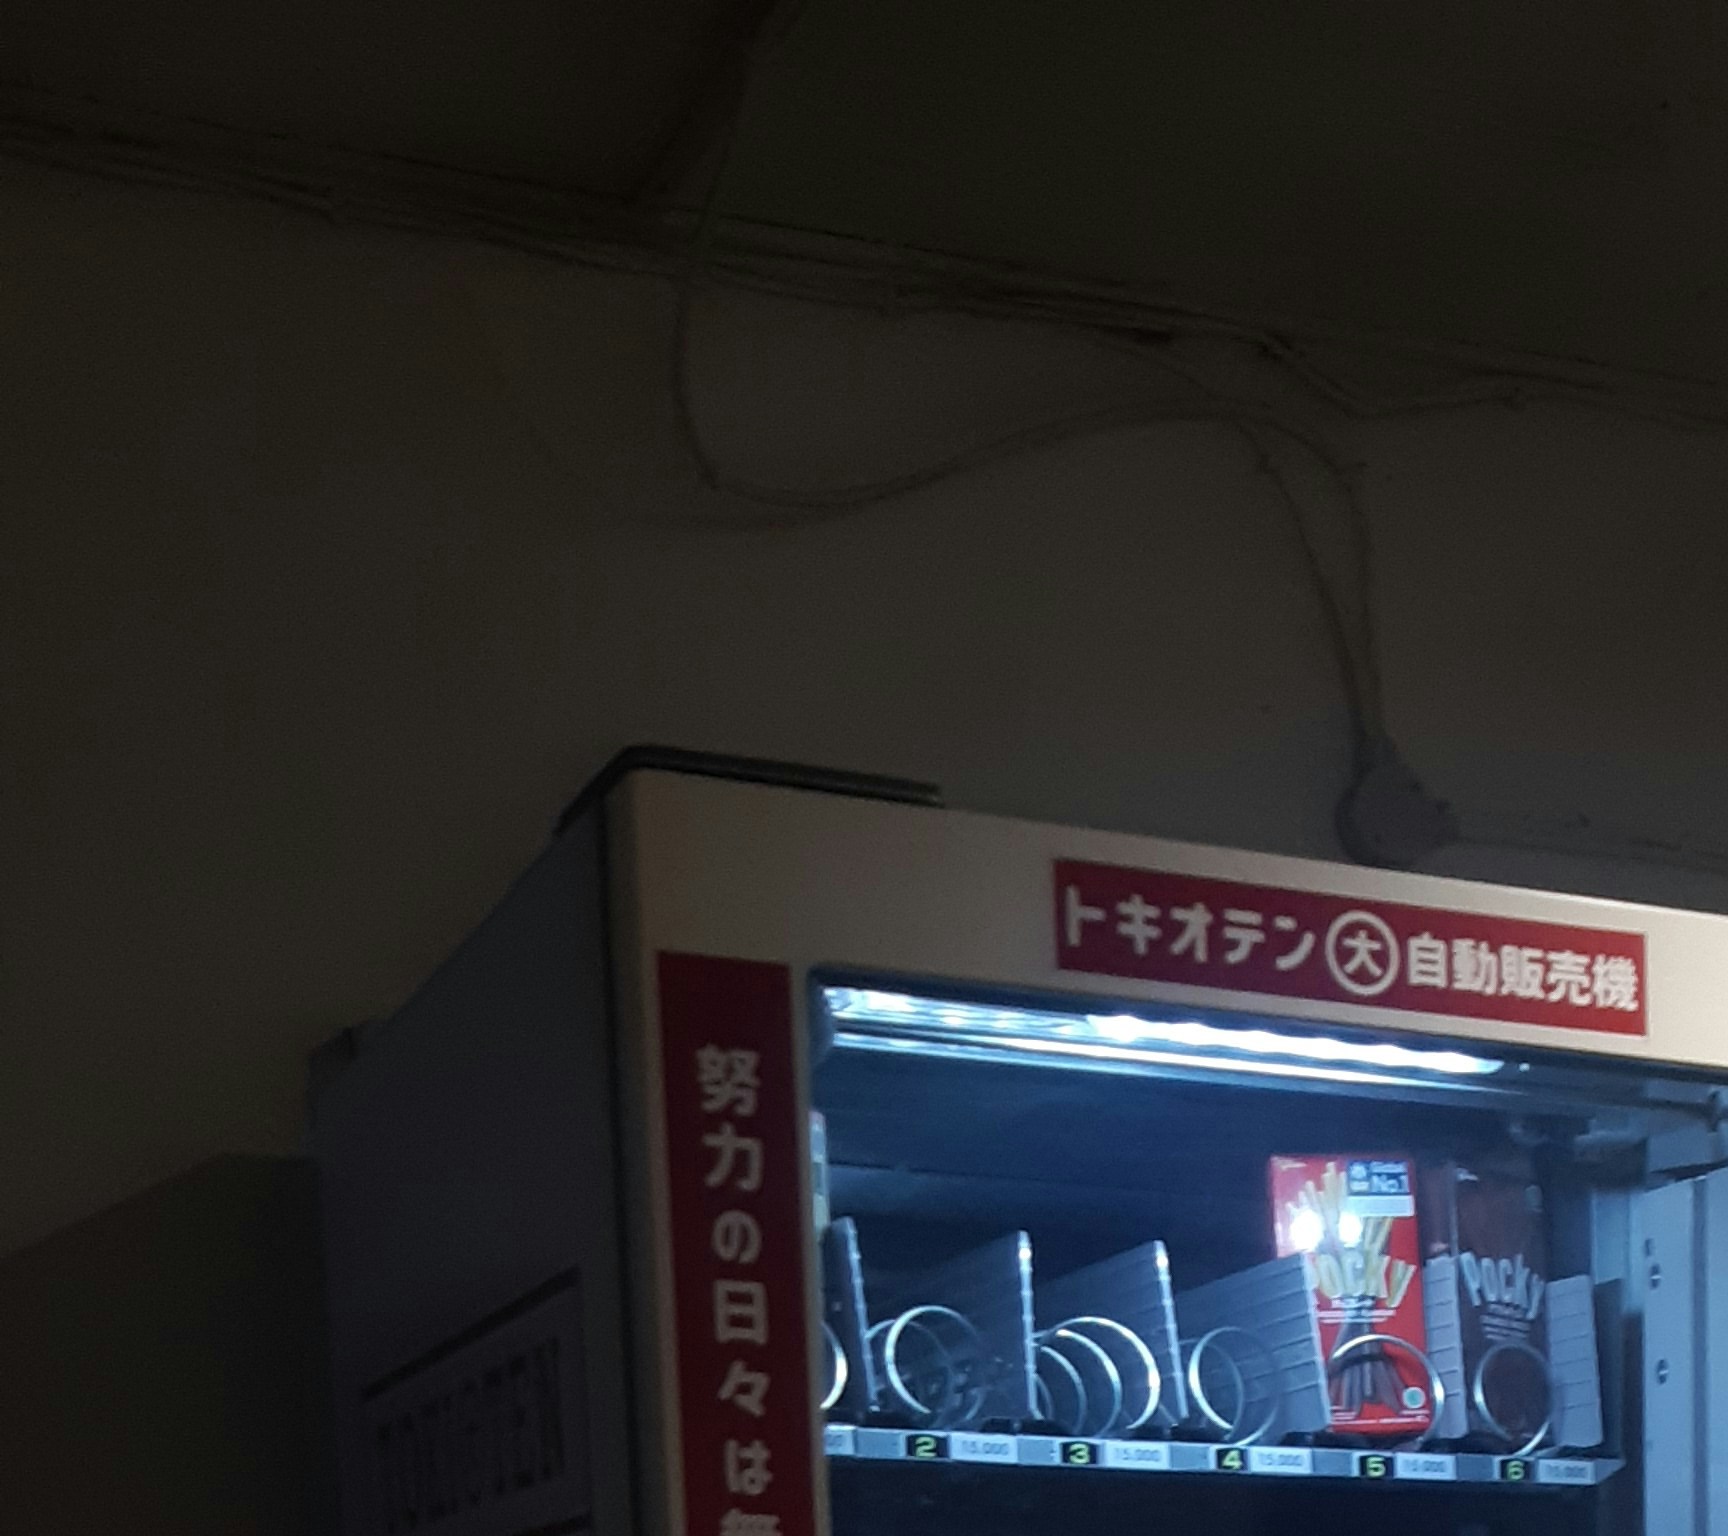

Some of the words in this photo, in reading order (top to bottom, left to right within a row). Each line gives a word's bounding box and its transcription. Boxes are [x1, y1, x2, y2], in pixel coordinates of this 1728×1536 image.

[1062, 884, 1315, 971] トキオテン
[1407, 931, 1639, 1012] 自動販売機
[913, 1436, 938, 1459] 2
[1068, 1443, 1090, 1465] 3
[1221, 1448, 1243, 1471] 4
[1365, 1456, 1386, 1479] 5
[1506, 1460, 1526, 1482] 6
